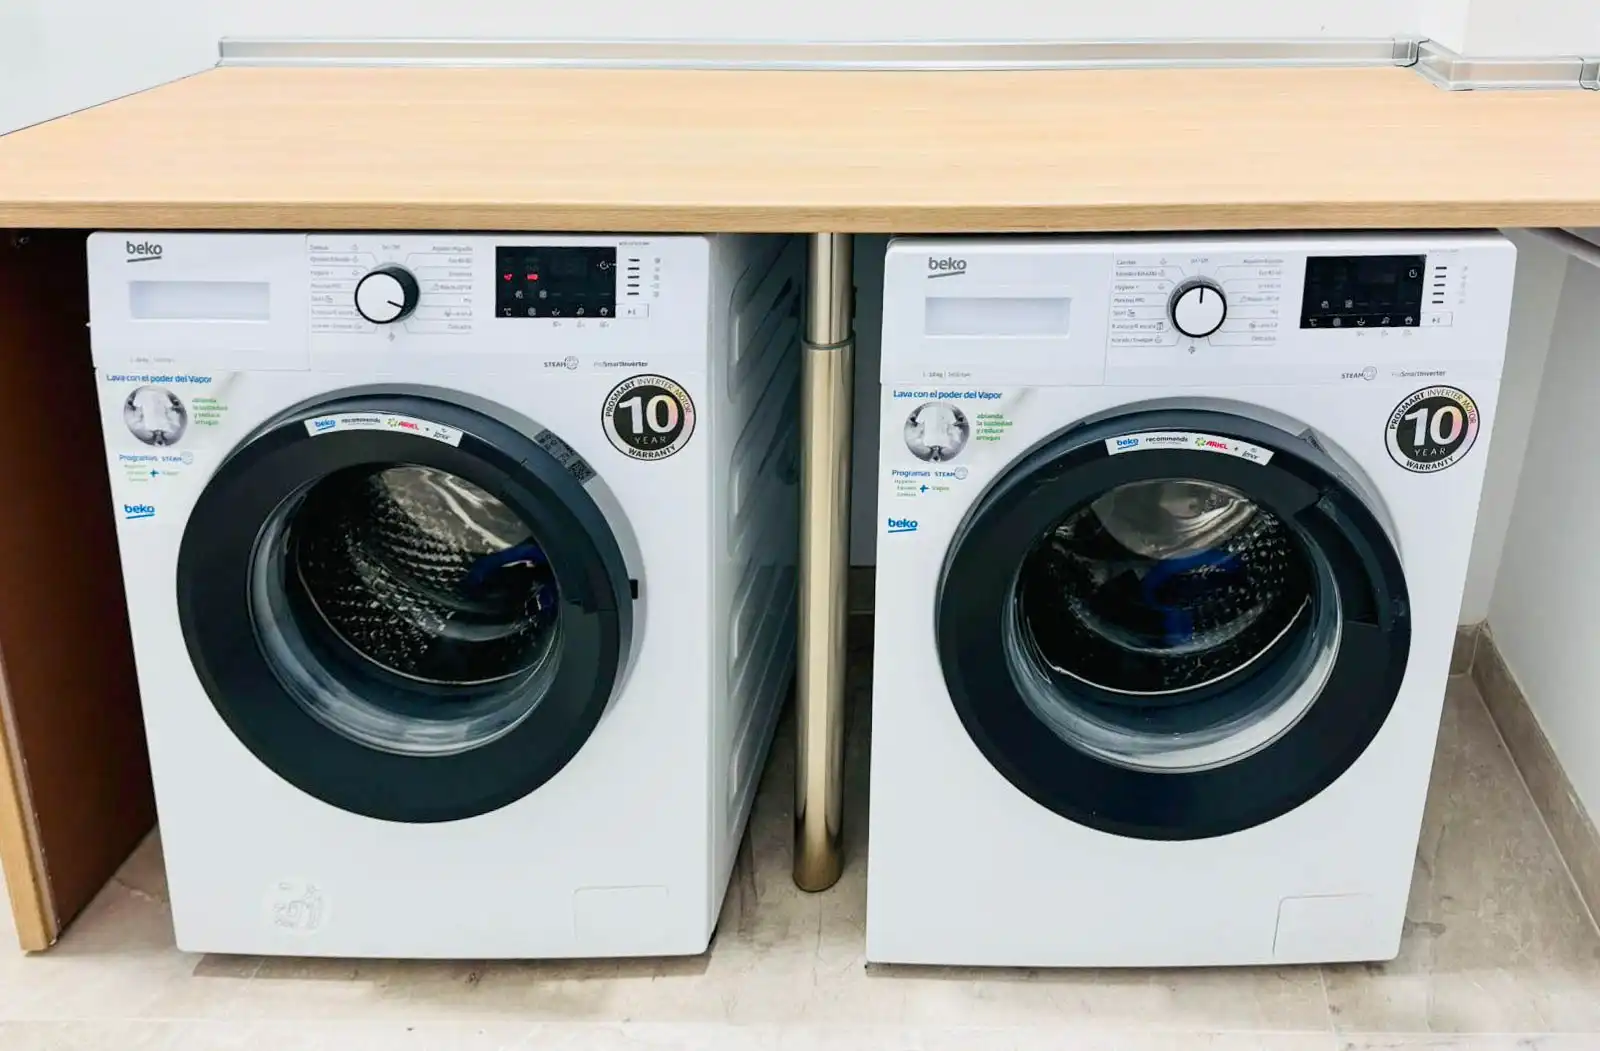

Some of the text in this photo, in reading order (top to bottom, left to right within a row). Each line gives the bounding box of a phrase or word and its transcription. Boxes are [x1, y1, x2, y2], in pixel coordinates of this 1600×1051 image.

[126, 241, 163, 255] beko
[928, 257, 967, 270] beko
[106, 374, 127, 382] Lava
[141, 374, 150, 382] el
[150, 375, 174, 384] poder
[175, 375, 188, 383] del
[188, 376, 212, 384] Vapor
[605, 377, 692, 417] PROSMART INVERTER MOTOR
[893, 390, 912, 398] Lava
[929, 390, 937, 398] el
[938, 391, 962, 399] poder
[963, 391, 977, 399] del
[978, 391, 1002, 400] Vapor
[619, 394, 679, 434] 10
[1390, 388, 1477, 430] PROSMART INVERTER MOTOR
[315, 419, 336, 428] beko
[1404, 405, 1463, 446] 10
[634, 435, 666, 444] YEAR
[1116, 437, 1139, 446] beko
[1206, 440, 1229, 450] ARIEL
[628, 444, 676, 458] WARRANTY
[1414, 447, 1446, 456] YEAR
[1406, 455, 1454, 470] WARRANTY
[891, 469, 930, 478] Programas
[124, 504, 156, 513] beko
[888, 518, 918, 528] beko
